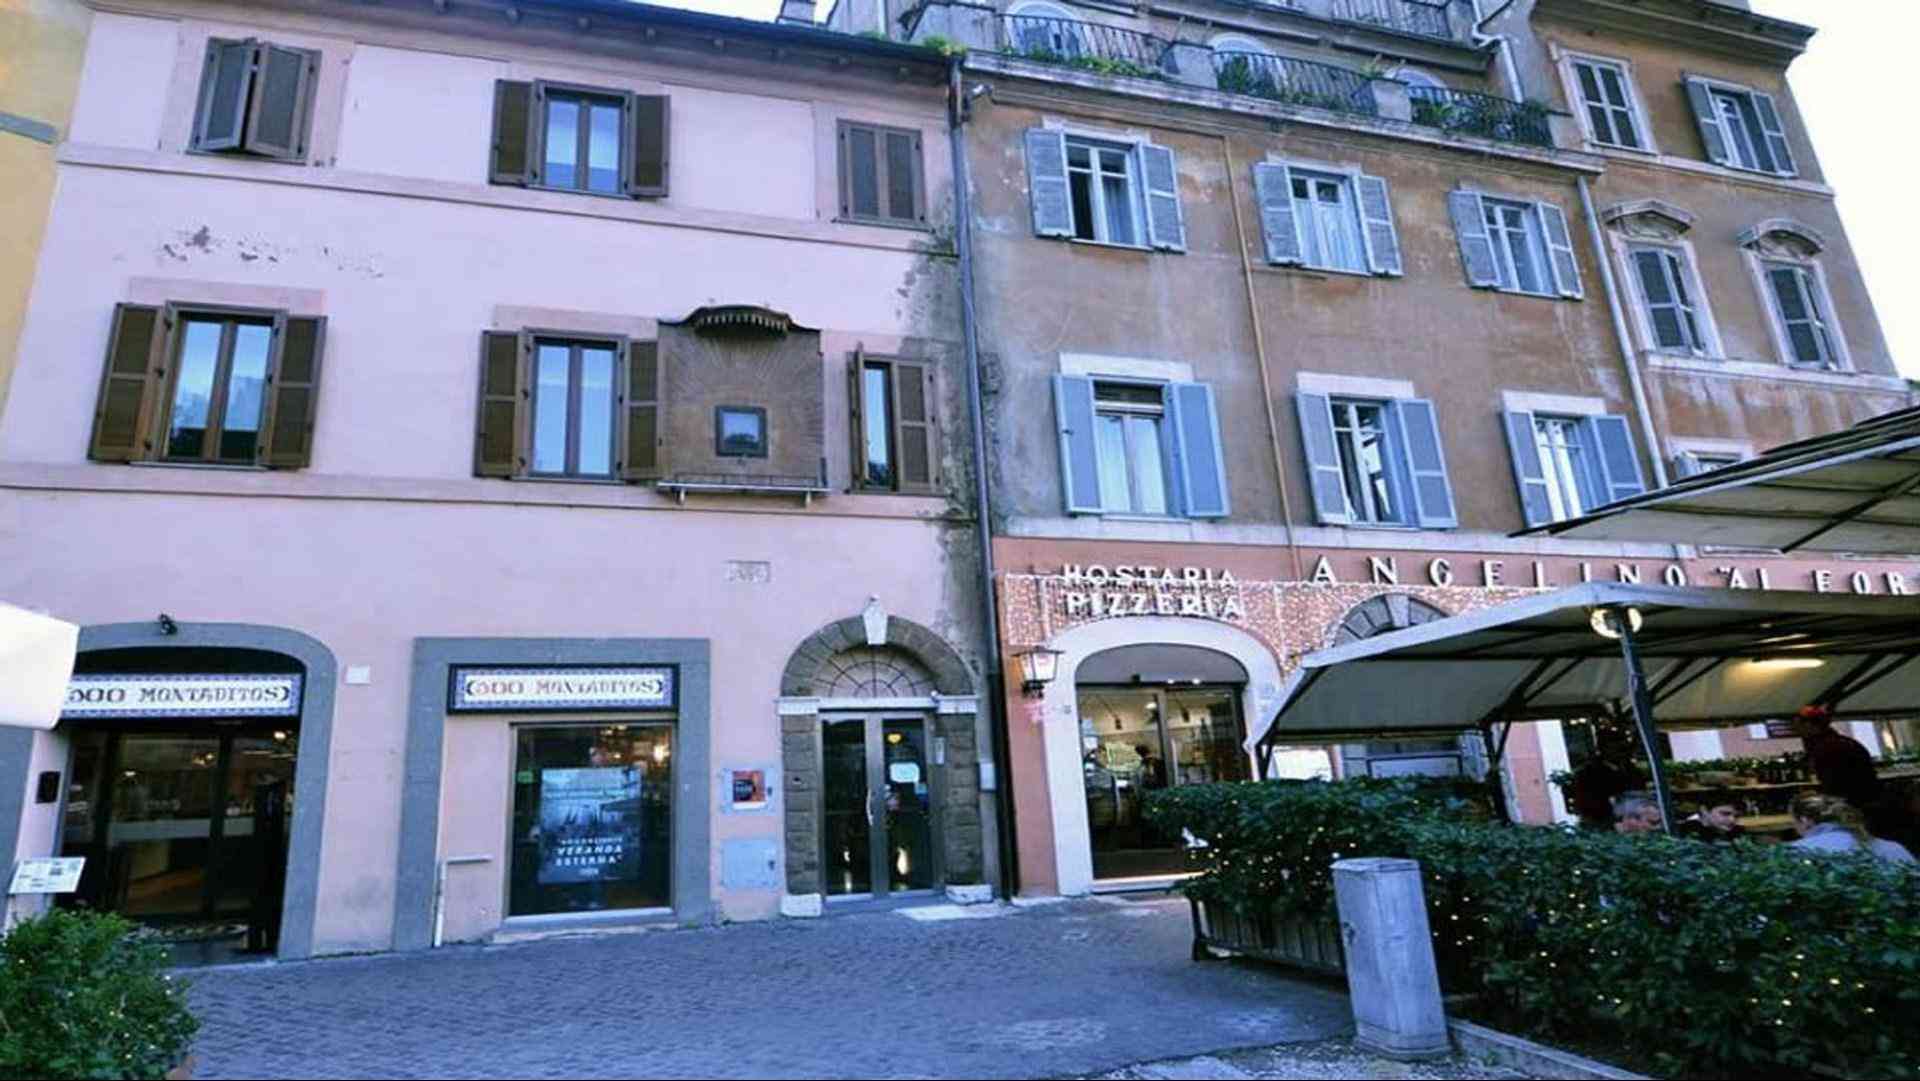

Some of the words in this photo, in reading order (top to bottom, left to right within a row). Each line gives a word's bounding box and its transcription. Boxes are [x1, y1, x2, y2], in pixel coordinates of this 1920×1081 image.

[1063, 564, 1237, 587] HOSTARIA
[1310, 555, 1686, 590] ANGELINO
[1066, 590, 1246, 617] PIZZERIA
[138, 686, 279, 703] MONTADITOS
